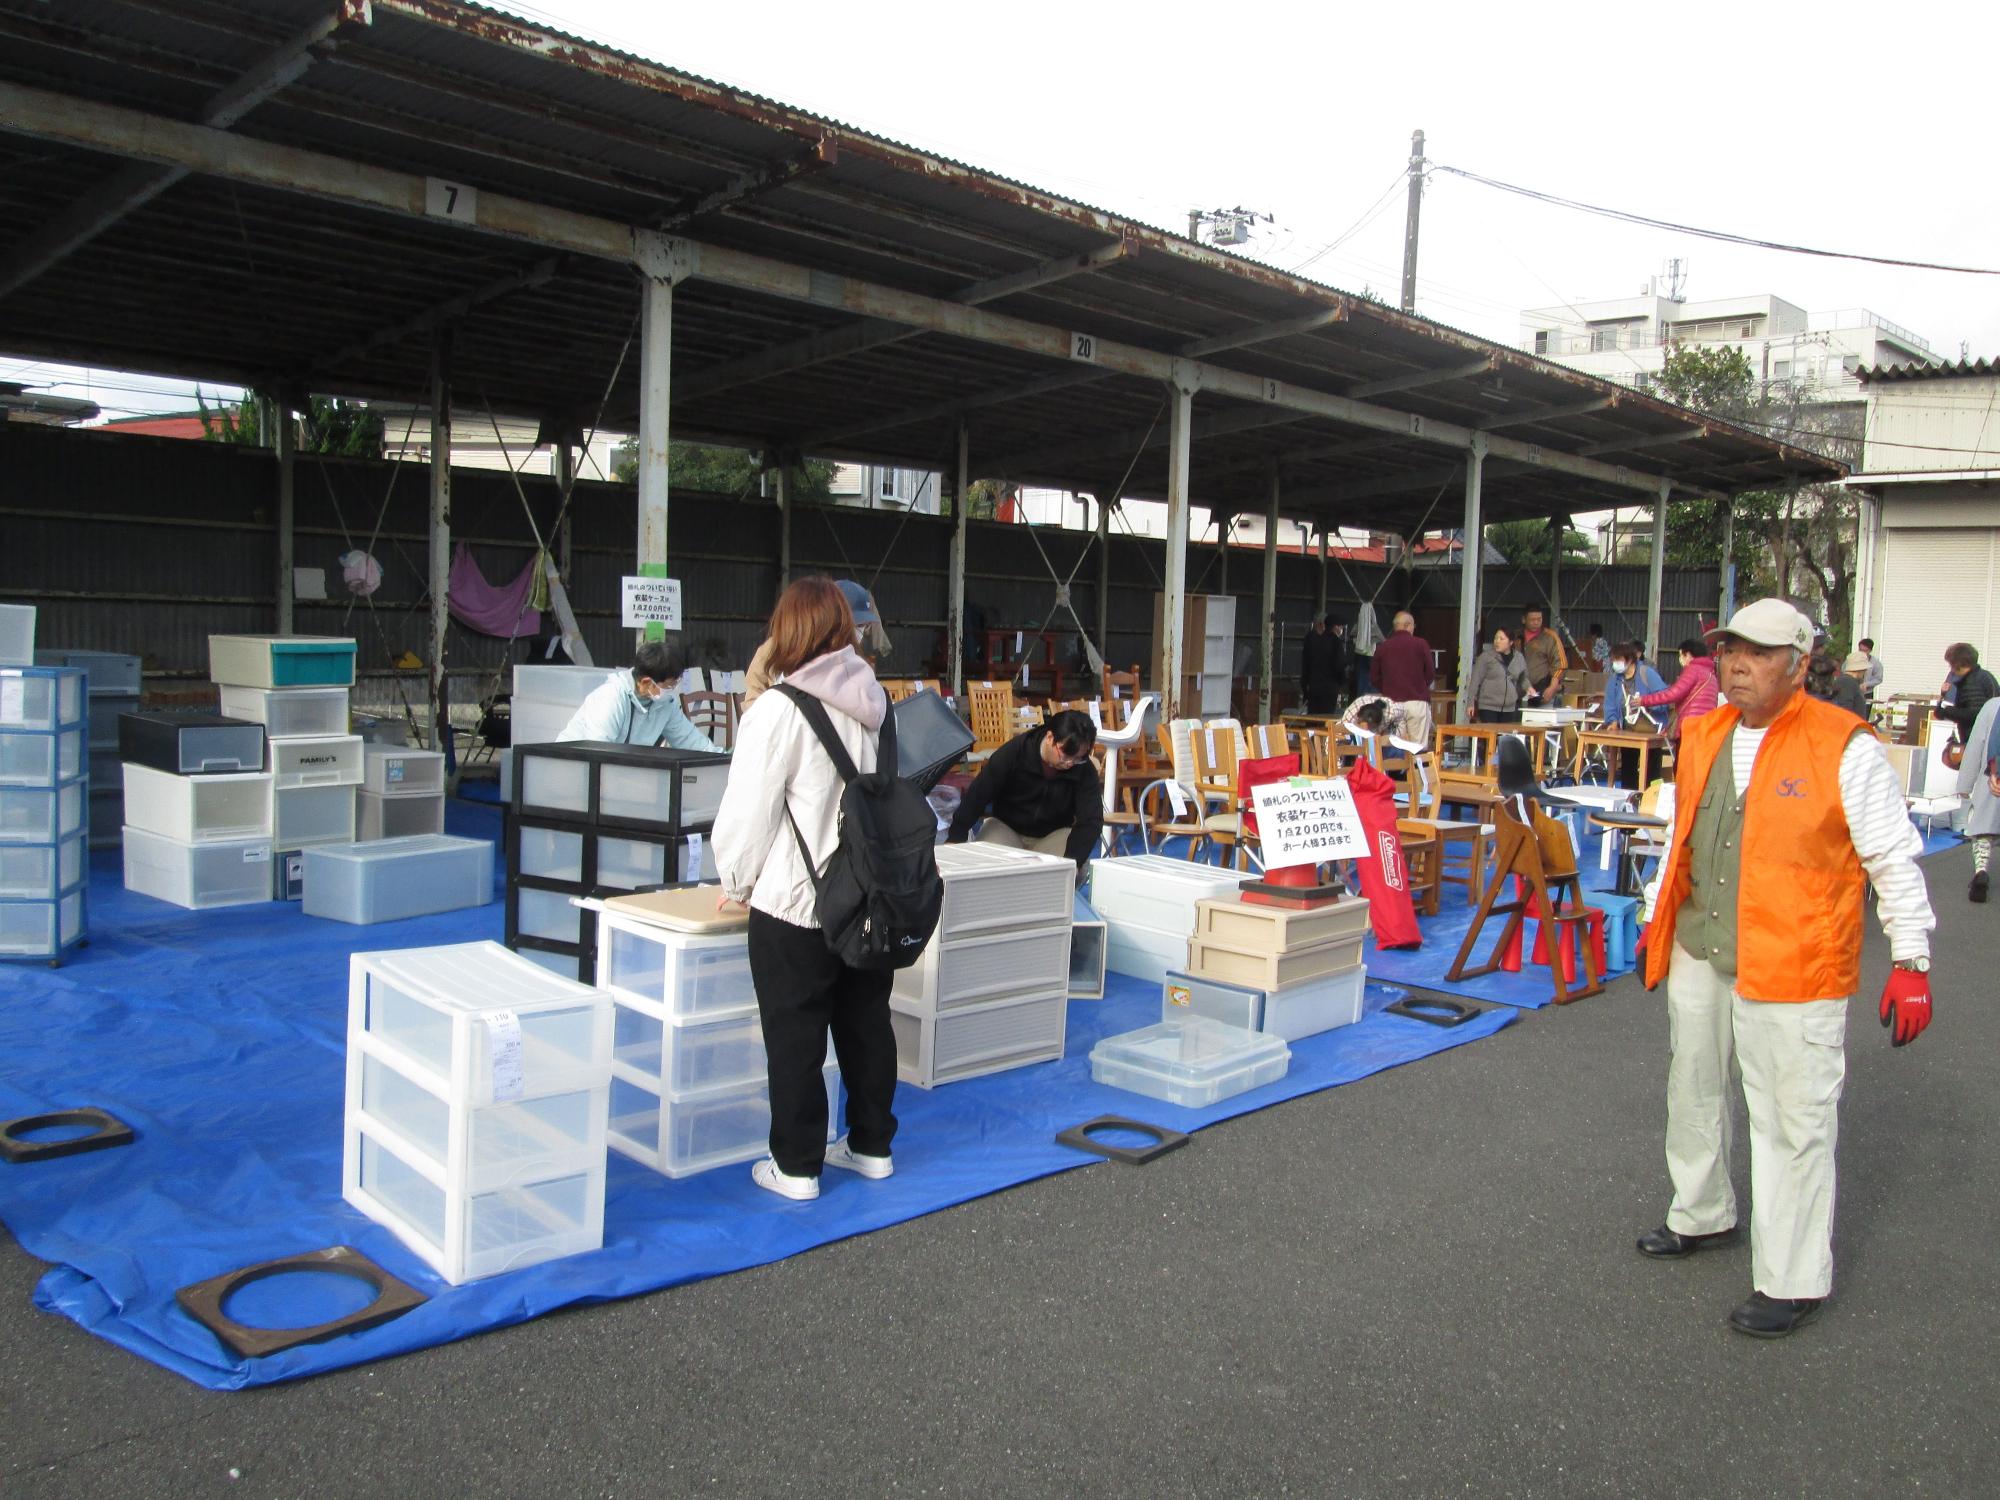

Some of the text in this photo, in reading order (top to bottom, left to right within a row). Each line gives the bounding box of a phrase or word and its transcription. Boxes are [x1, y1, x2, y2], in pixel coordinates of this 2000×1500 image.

[445, 186, 458, 214] 7
[1077, 336, 1091, 358] 20
[1270, 382, 1276, 399] 3
[1414, 417, 1420, 433] 2
[1262, 789, 1347, 808] 値札のついていない
